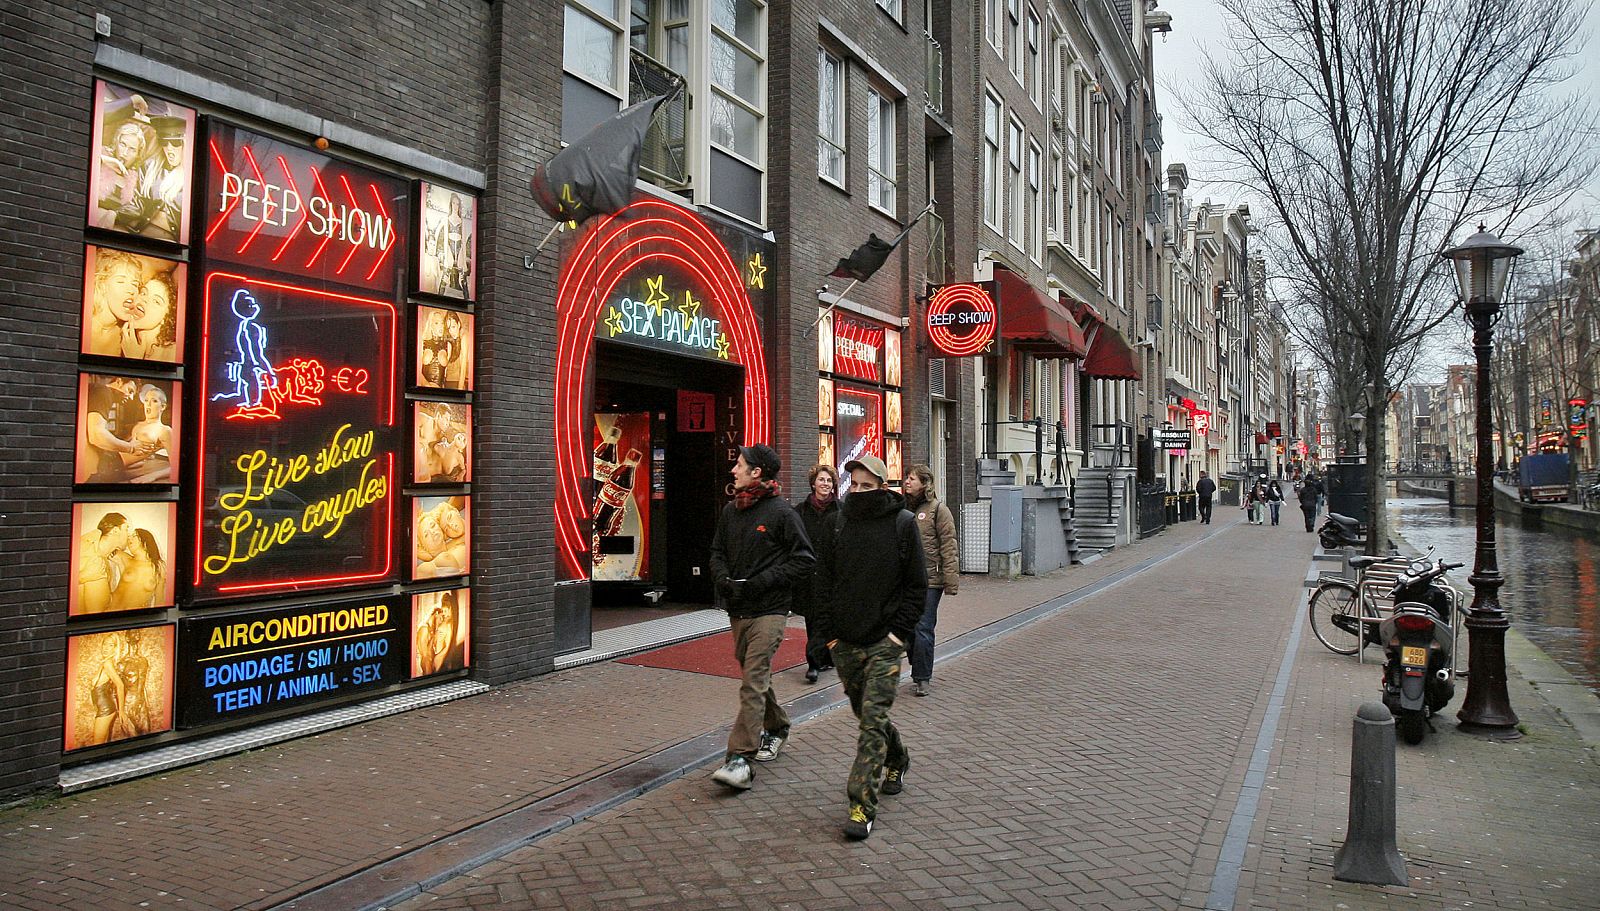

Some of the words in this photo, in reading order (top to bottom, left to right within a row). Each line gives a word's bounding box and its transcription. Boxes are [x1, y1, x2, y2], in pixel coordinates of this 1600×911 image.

[219, 172, 301, 227] PEEP
[306, 196, 392, 251] SHOW
[619, 297, 656, 338] SEX
[658, 308, 720, 351] PALACE
[930, 313, 956, 326] PEEP
[958, 311, 992, 324] SHOW
[835, 335, 855, 358] PEEP
[855, 341, 877, 364] SHOW
[726, 396, 738, 461] LIVE
[220, 449, 311, 511] Live
[314, 423, 374, 475] show
[204, 510, 297, 575] Live
[301, 458, 388, 539] couples
[208, 604, 389, 651] AIRCONDITIONED
[204, 653, 295, 688] BONDAGE
[307, 647, 331, 669] SM
[343, 638, 389, 662] HOMO
[213, 685, 262, 713] TEEN
[277, 671, 339, 701] ANIMAL
[352, 662, 382, 685] SEX
